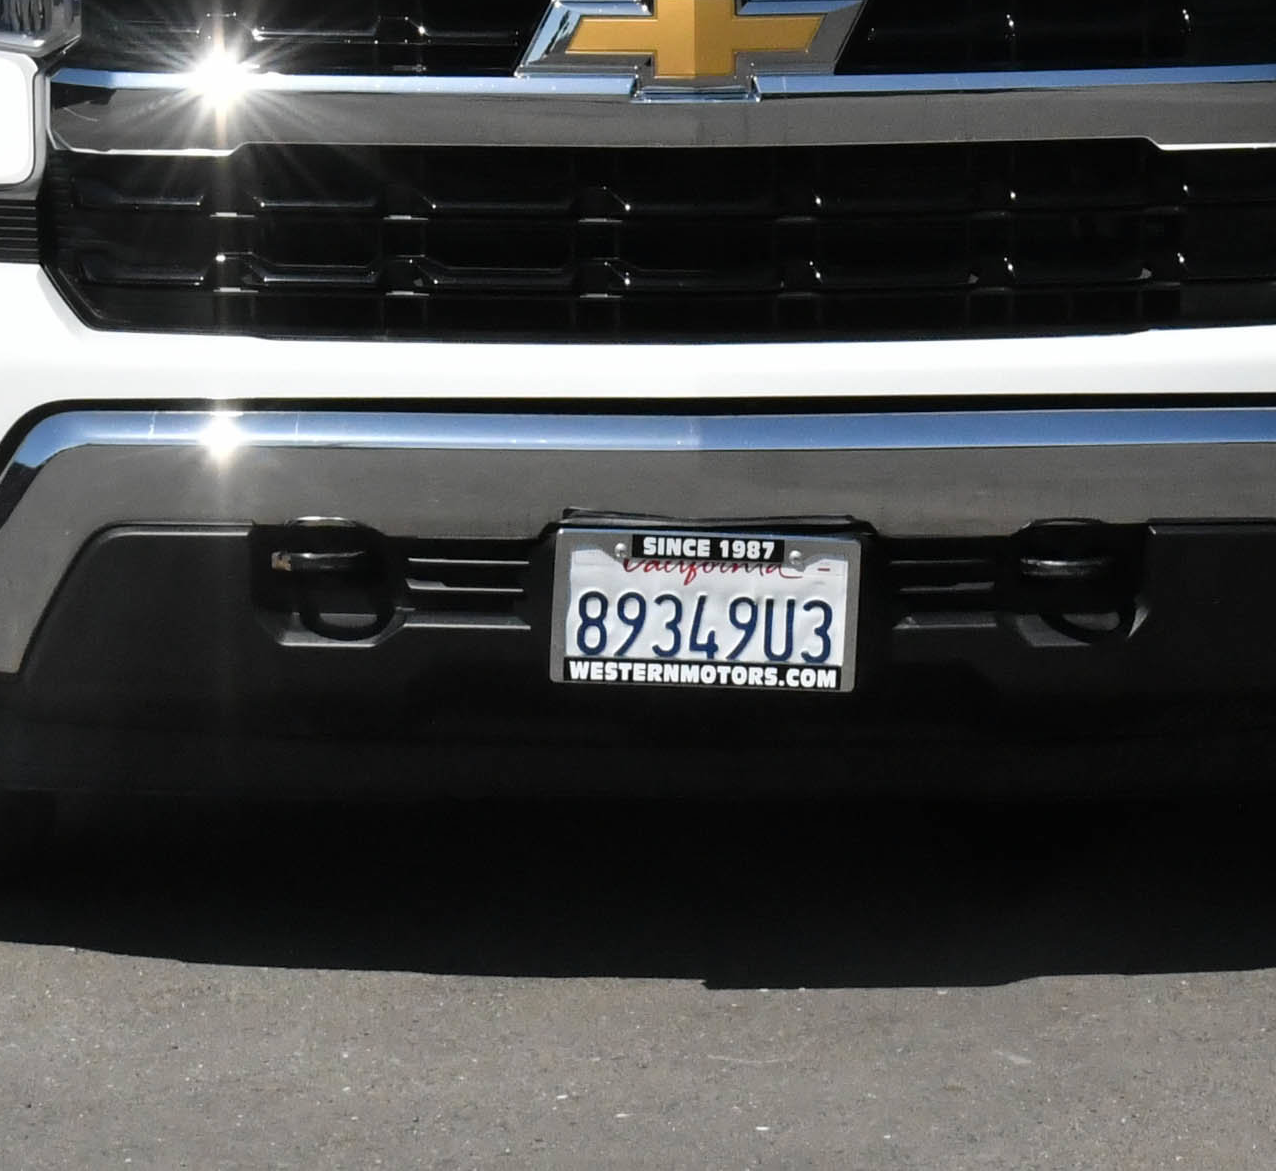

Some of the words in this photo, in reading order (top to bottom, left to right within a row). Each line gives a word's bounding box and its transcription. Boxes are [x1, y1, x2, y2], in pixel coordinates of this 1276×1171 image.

[643, 536, 711, 558] SINCE
[719, 540, 775, 560] 1987
[576, 590, 834, 664] 89349U3
[569, 661, 837, 689] WESTERNMOTORS.COM
